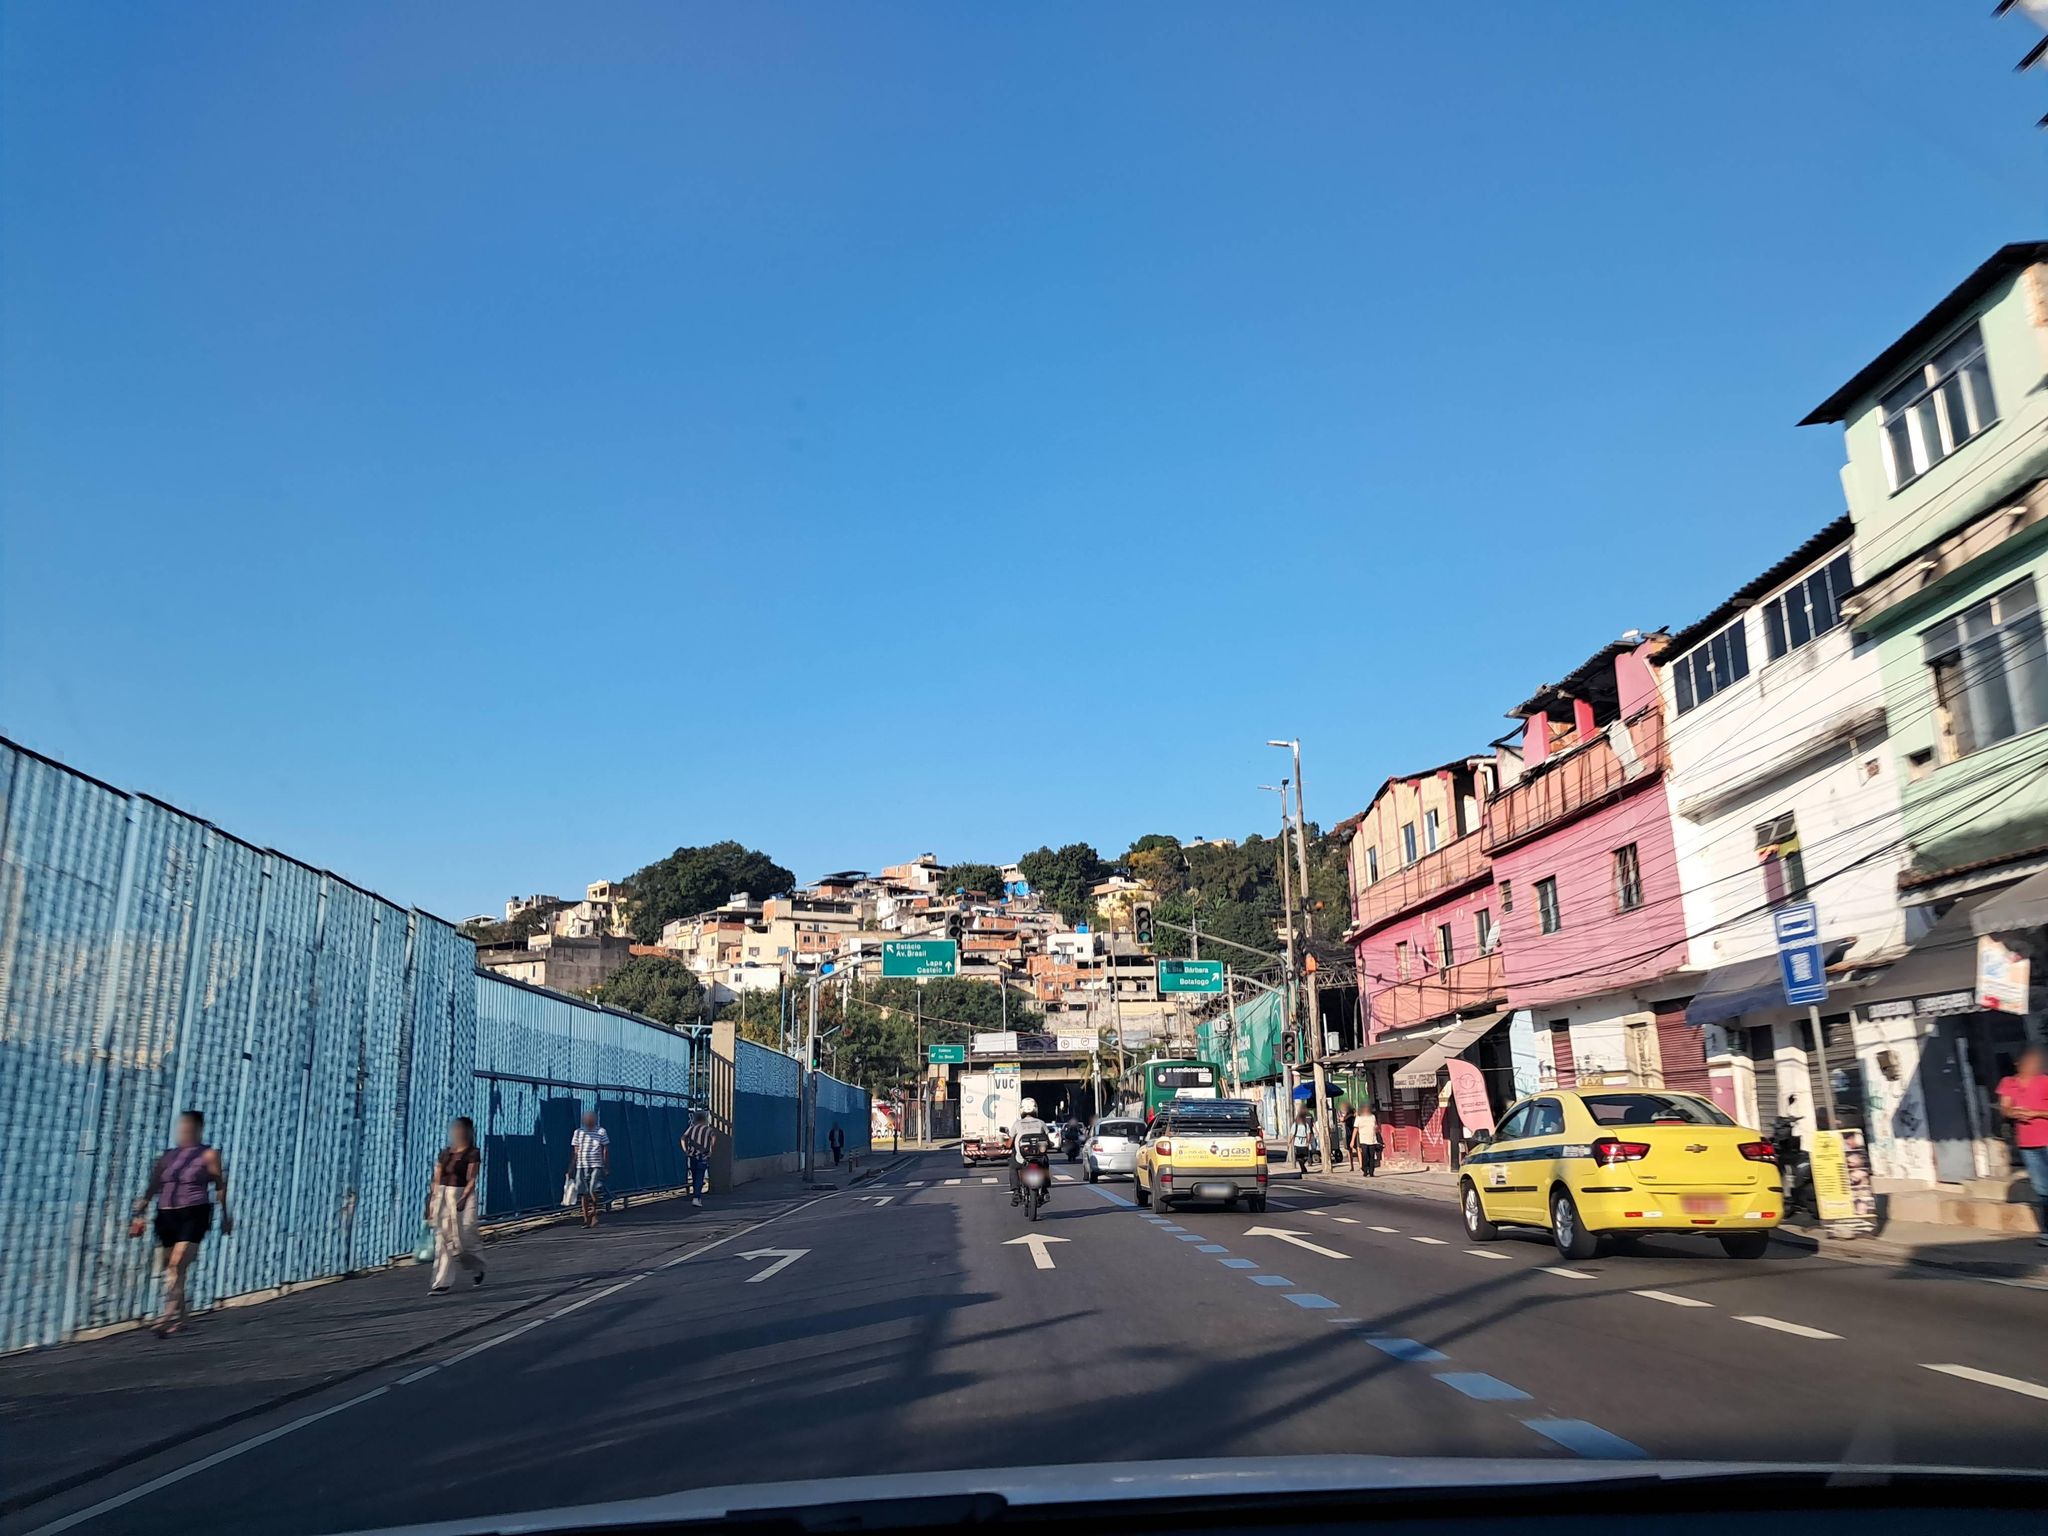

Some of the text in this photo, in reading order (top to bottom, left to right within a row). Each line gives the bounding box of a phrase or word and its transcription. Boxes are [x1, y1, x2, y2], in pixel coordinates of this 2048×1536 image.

[1179, 978, 1209, 986] Botafogo
[995, 1078, 1015, 1089] VUC
[1231, 1146, 1251, 1155] casa
